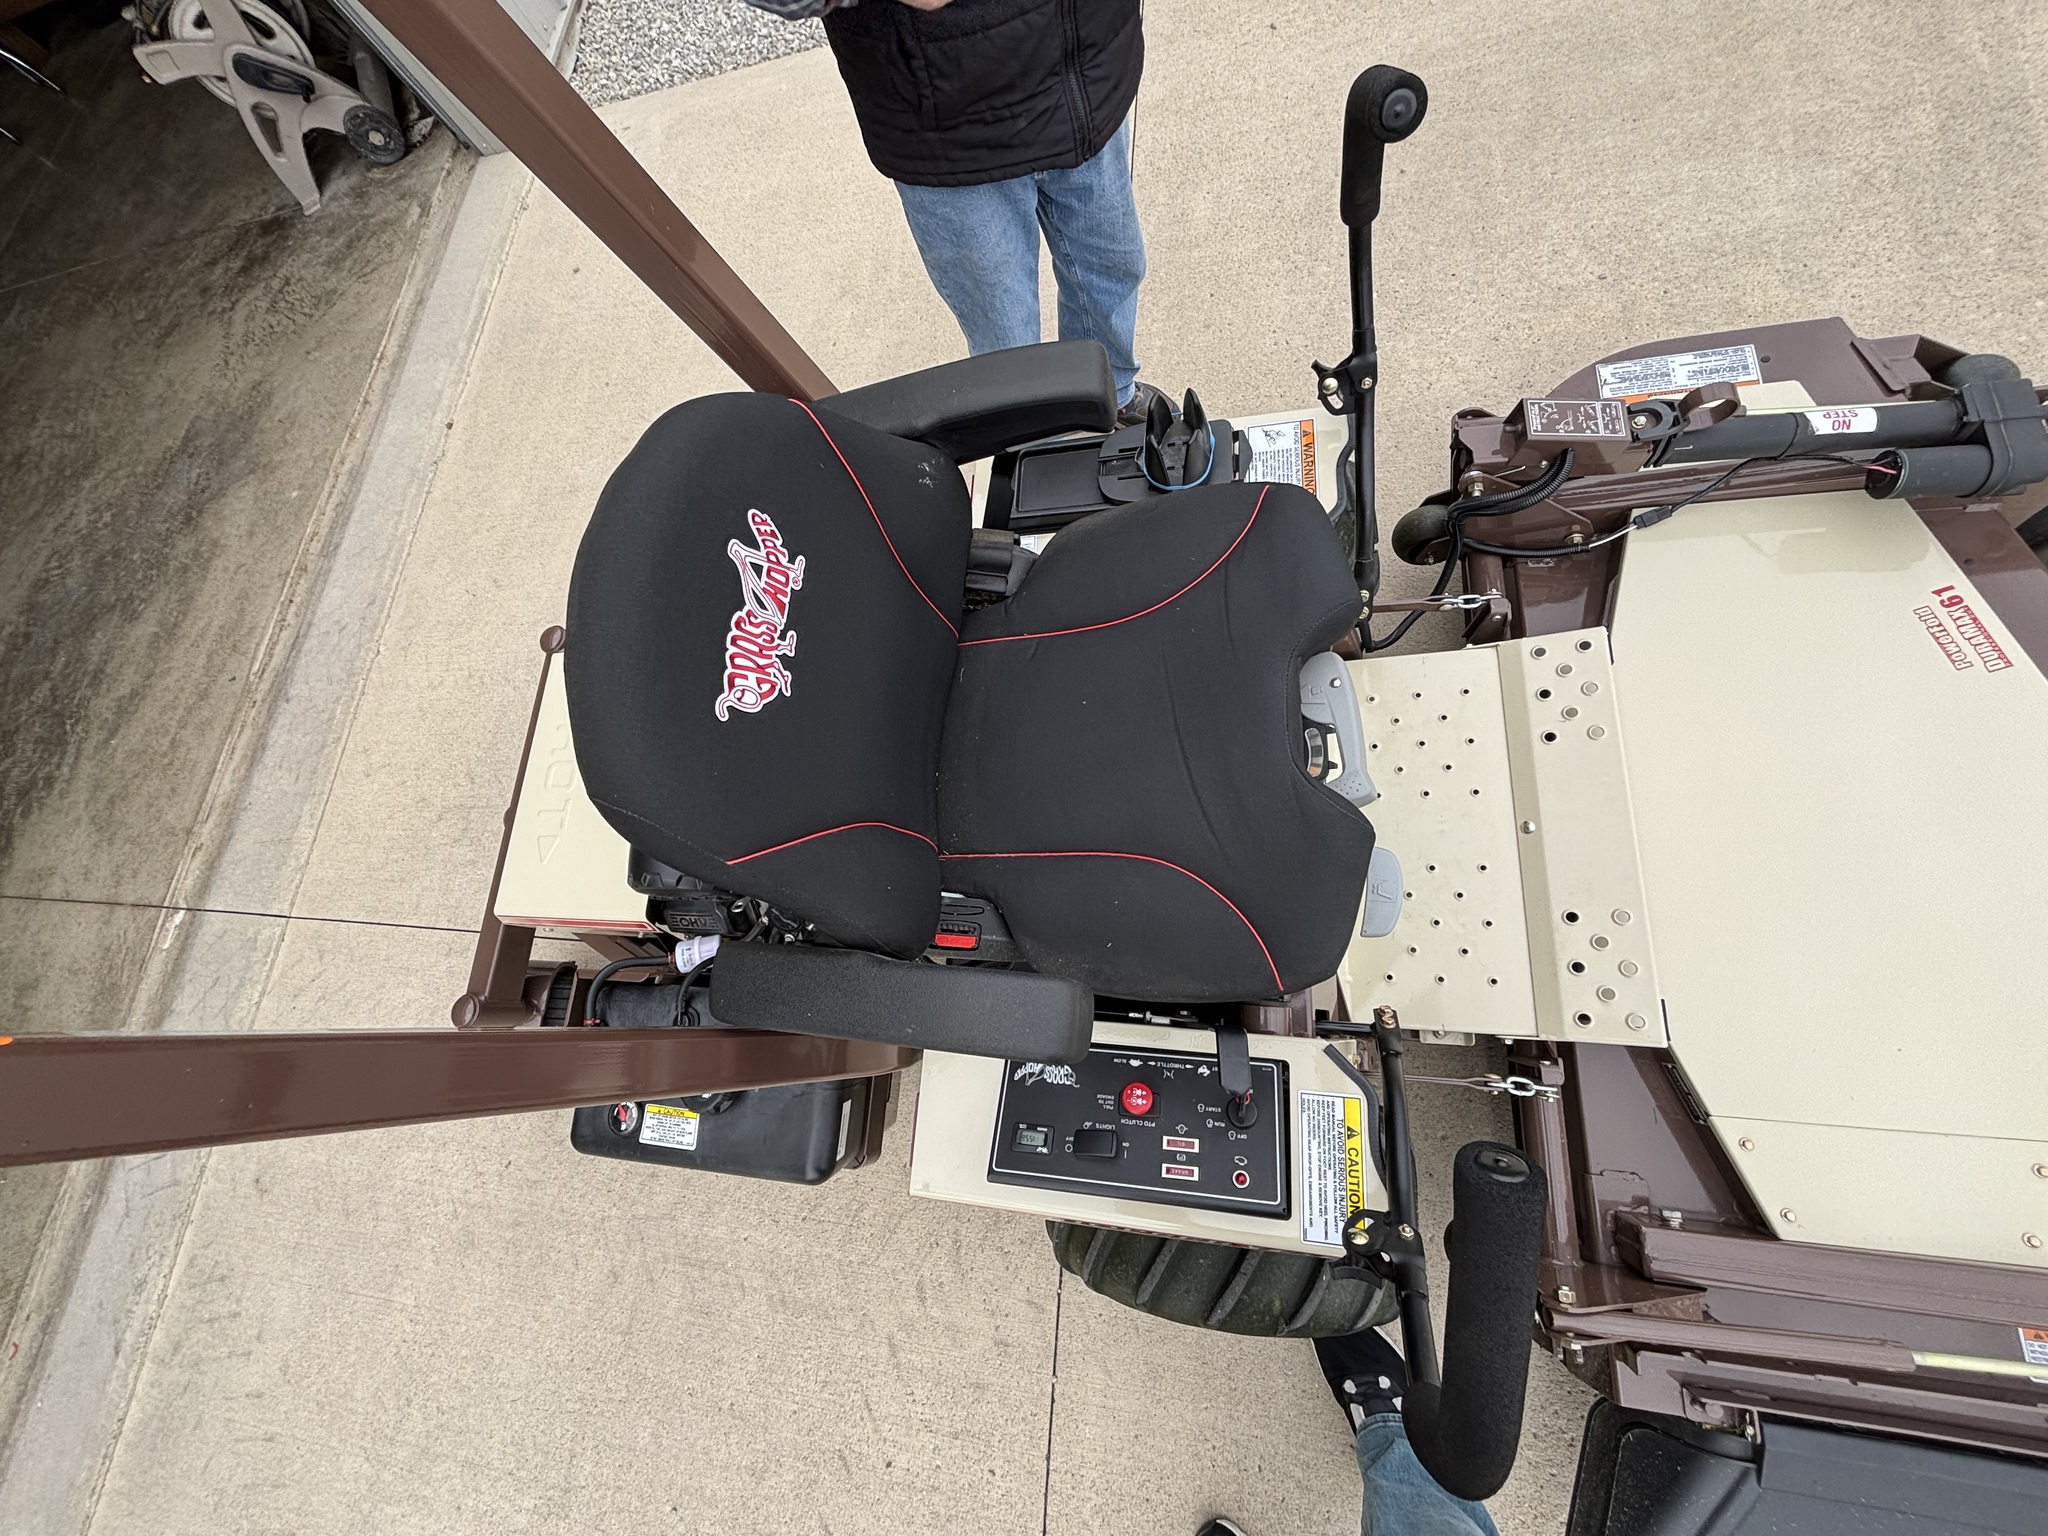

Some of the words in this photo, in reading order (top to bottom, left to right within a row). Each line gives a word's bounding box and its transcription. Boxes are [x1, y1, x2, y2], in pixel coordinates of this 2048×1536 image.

[1822, 410, 1858, 419] STEP
[1832, 419, 1852, 431] NO
[726, 512, 794, 707] GRASSHOPPER
[1931, 585, 1965, 608] 61
[1913, 606, 1974, 671] PowerFold
[1947, 607, 2005, 673] DURAMAX
[1337, 1119, 1343, 1129] TO
[1348, 1147, 1361, 1214] CAUTION
